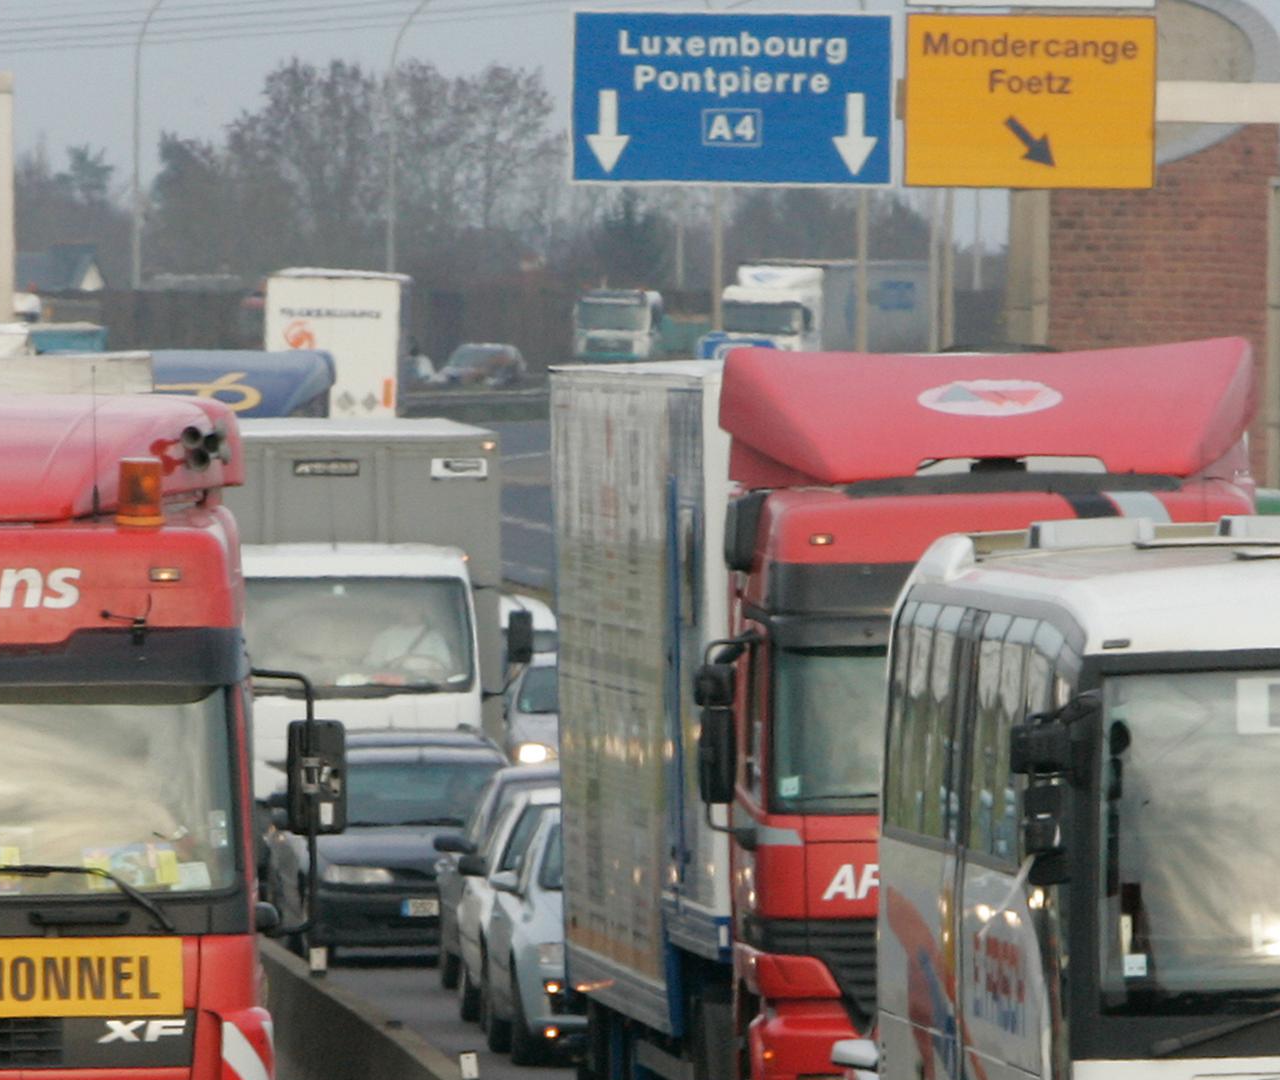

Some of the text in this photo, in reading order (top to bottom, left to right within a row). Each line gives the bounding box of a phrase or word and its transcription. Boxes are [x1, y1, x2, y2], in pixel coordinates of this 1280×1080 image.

[619, 29, 848, 65] Luxembourg
[922, 32, 1138, 64] Mondercange
[634, 65, 830, 98] Pontpierre
[989, 69, 1072, 95] Foetz
[708, 114, 756, 141] A4
[97, 1020, 187, 1043] XF
